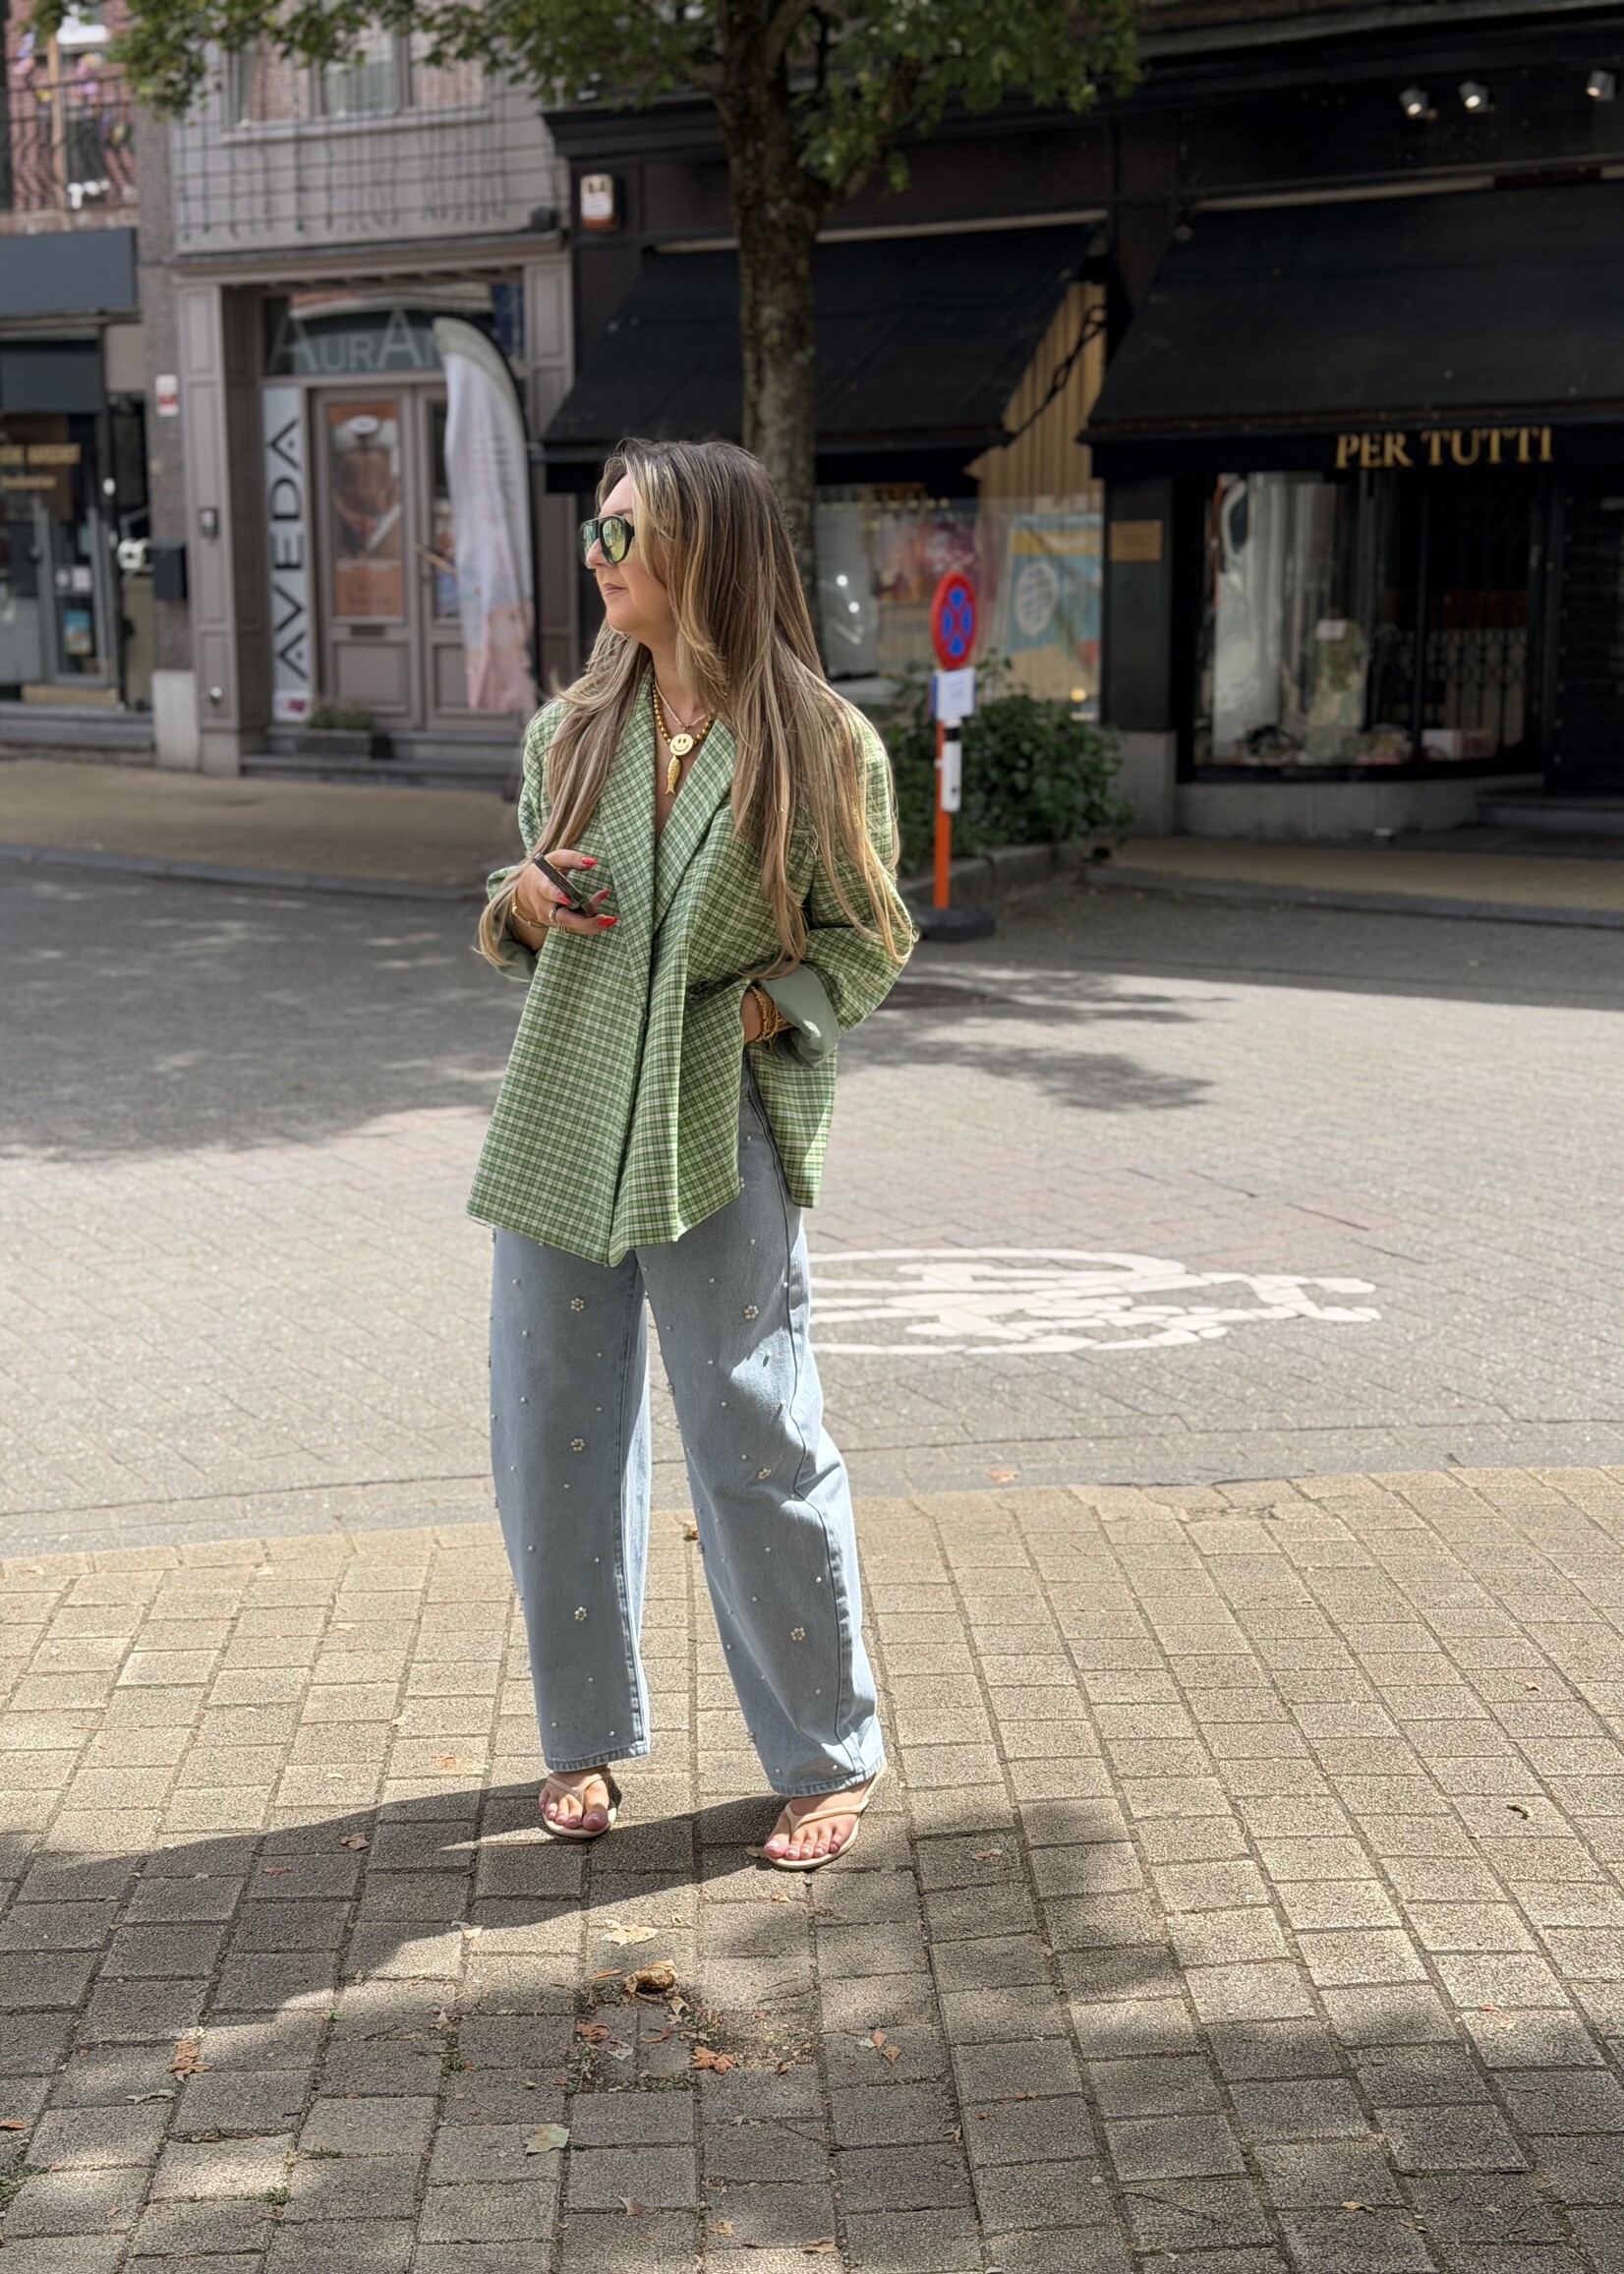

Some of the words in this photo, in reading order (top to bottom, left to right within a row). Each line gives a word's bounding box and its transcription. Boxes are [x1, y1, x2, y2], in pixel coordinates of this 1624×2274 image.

[1335, 431, 1414, 469] PER
[1420, 426, 1553, 467] TUTTI
[267, 417, 309, 681] AVEDA
